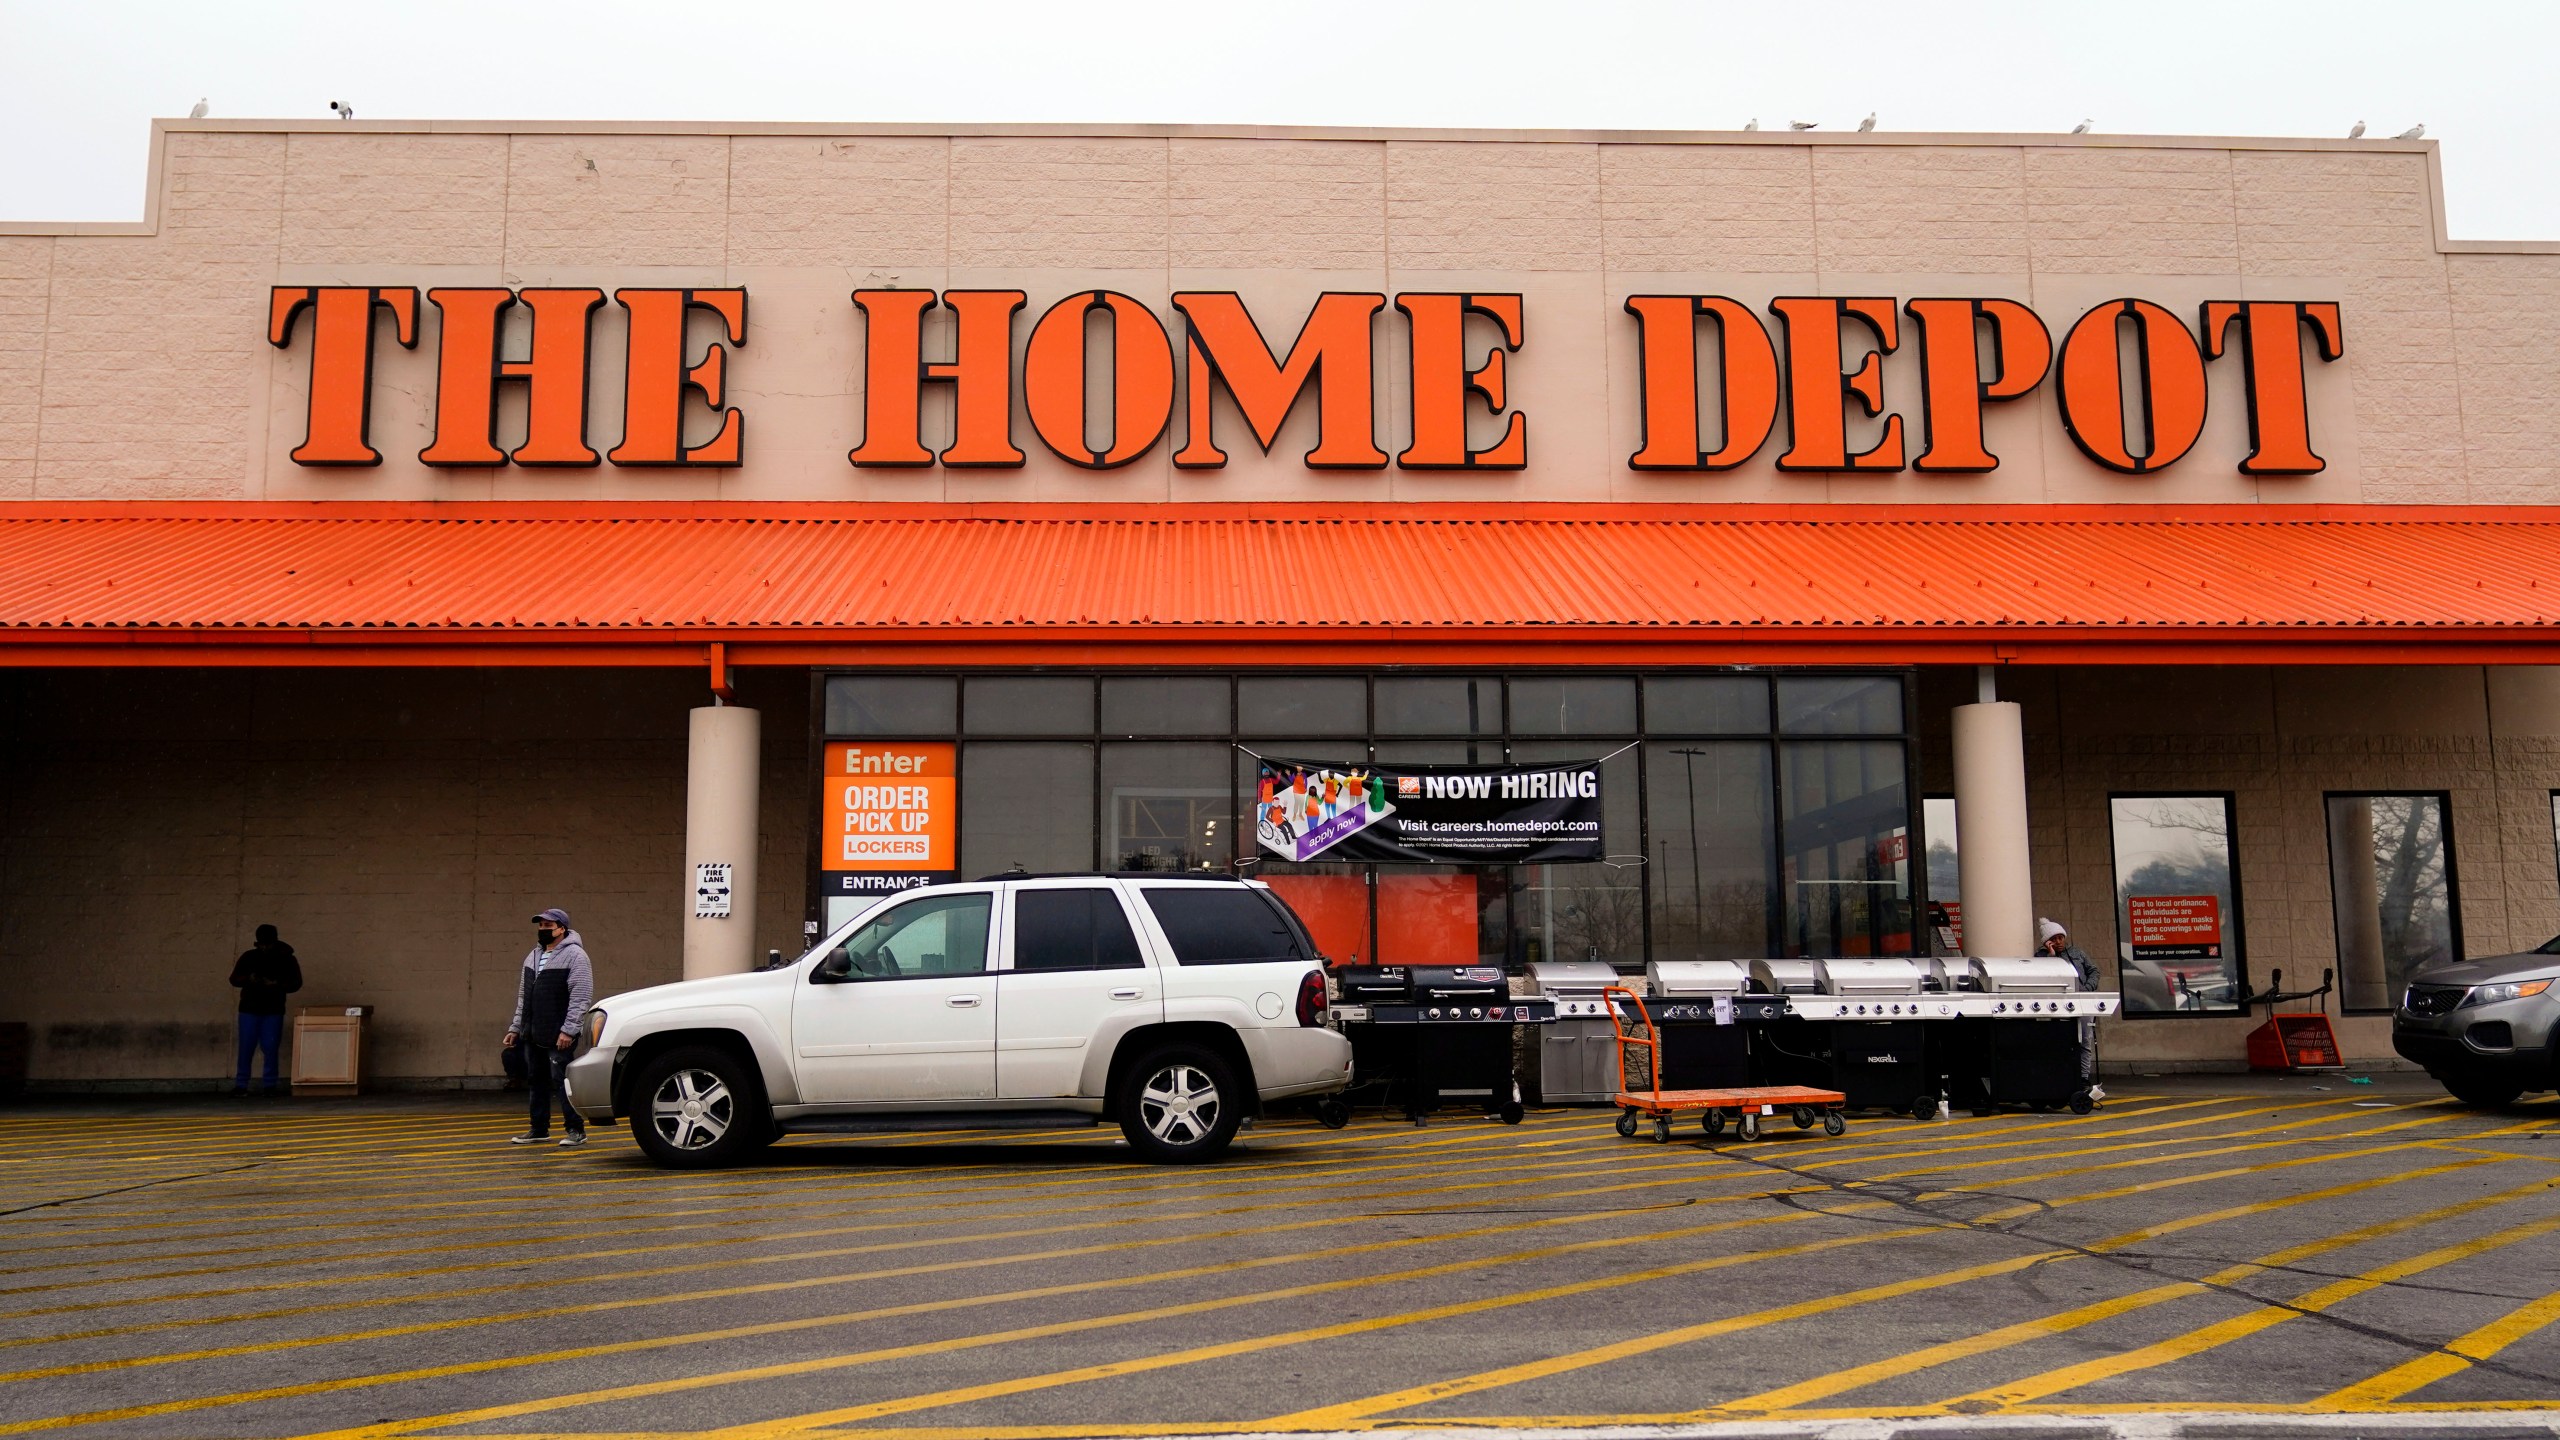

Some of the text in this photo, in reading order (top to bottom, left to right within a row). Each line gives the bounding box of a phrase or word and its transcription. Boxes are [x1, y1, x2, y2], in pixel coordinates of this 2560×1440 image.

[267, 284, 2345, 477] THE HOME DEPOT
[846, 748, 928, 774] Enter
[1425, 770, 1597, 800] NOW HIRING
[844, 785, 930, 810] ORDER
[845, 811, 930, 833] PICK UP
[1398, 819, 1598, 834] Visit careers.homedepot.com
[1308, 815, 1357, 847] apply now
[847, 841, 926, 854] LOCKERS
[1142, 845, 1161, 856] LED
[1142, 855, 1178, 867] BRIGHT
[842, 876, 930, 889] ENTRANCE
[2132, 900, 2145, 908] Due
[2155, 899, 2172, 907] local
[2173, 899, 2209, 907] ordinance,
[2142, 908, 2180, 916] individuals
[2133, 917, 2162, 926] required
[2191, 916, 2214, 924] masks
[2159, 925, 2192, 934] coverings
[2143, 934, 2166, 943] public.
[1867, 1053, 1898, 1063] NEXGRILL
